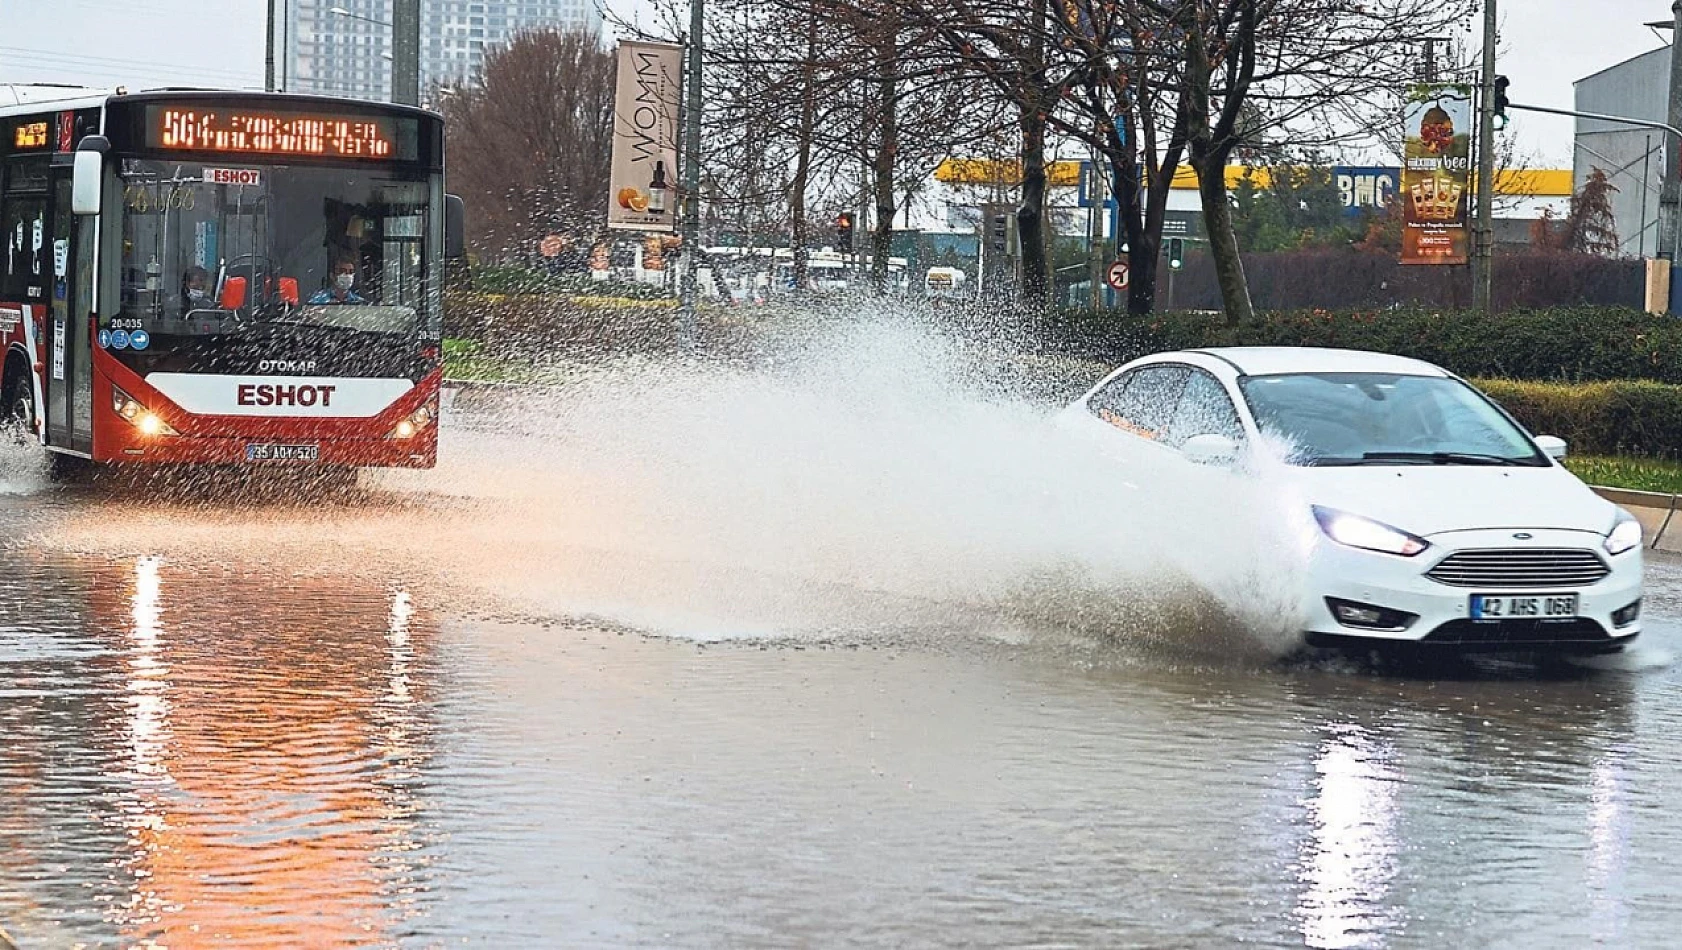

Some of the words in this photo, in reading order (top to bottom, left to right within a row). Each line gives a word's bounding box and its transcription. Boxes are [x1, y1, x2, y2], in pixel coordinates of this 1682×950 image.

[631, 52, 659, 162] WOMM
[1443, 154, 1466, 169] bee
[215, 169, 257, 184] ESHOT
[1337, 174, 1393, 208] BMC
[111, 318, 142, 328] 20-035
[259, 359, 316, 372] OTOKAR
[237, 384, 336, 407] ESHOT
[255, 445, 269, 459] 35
[1481, 598, 1502, 616] 42
